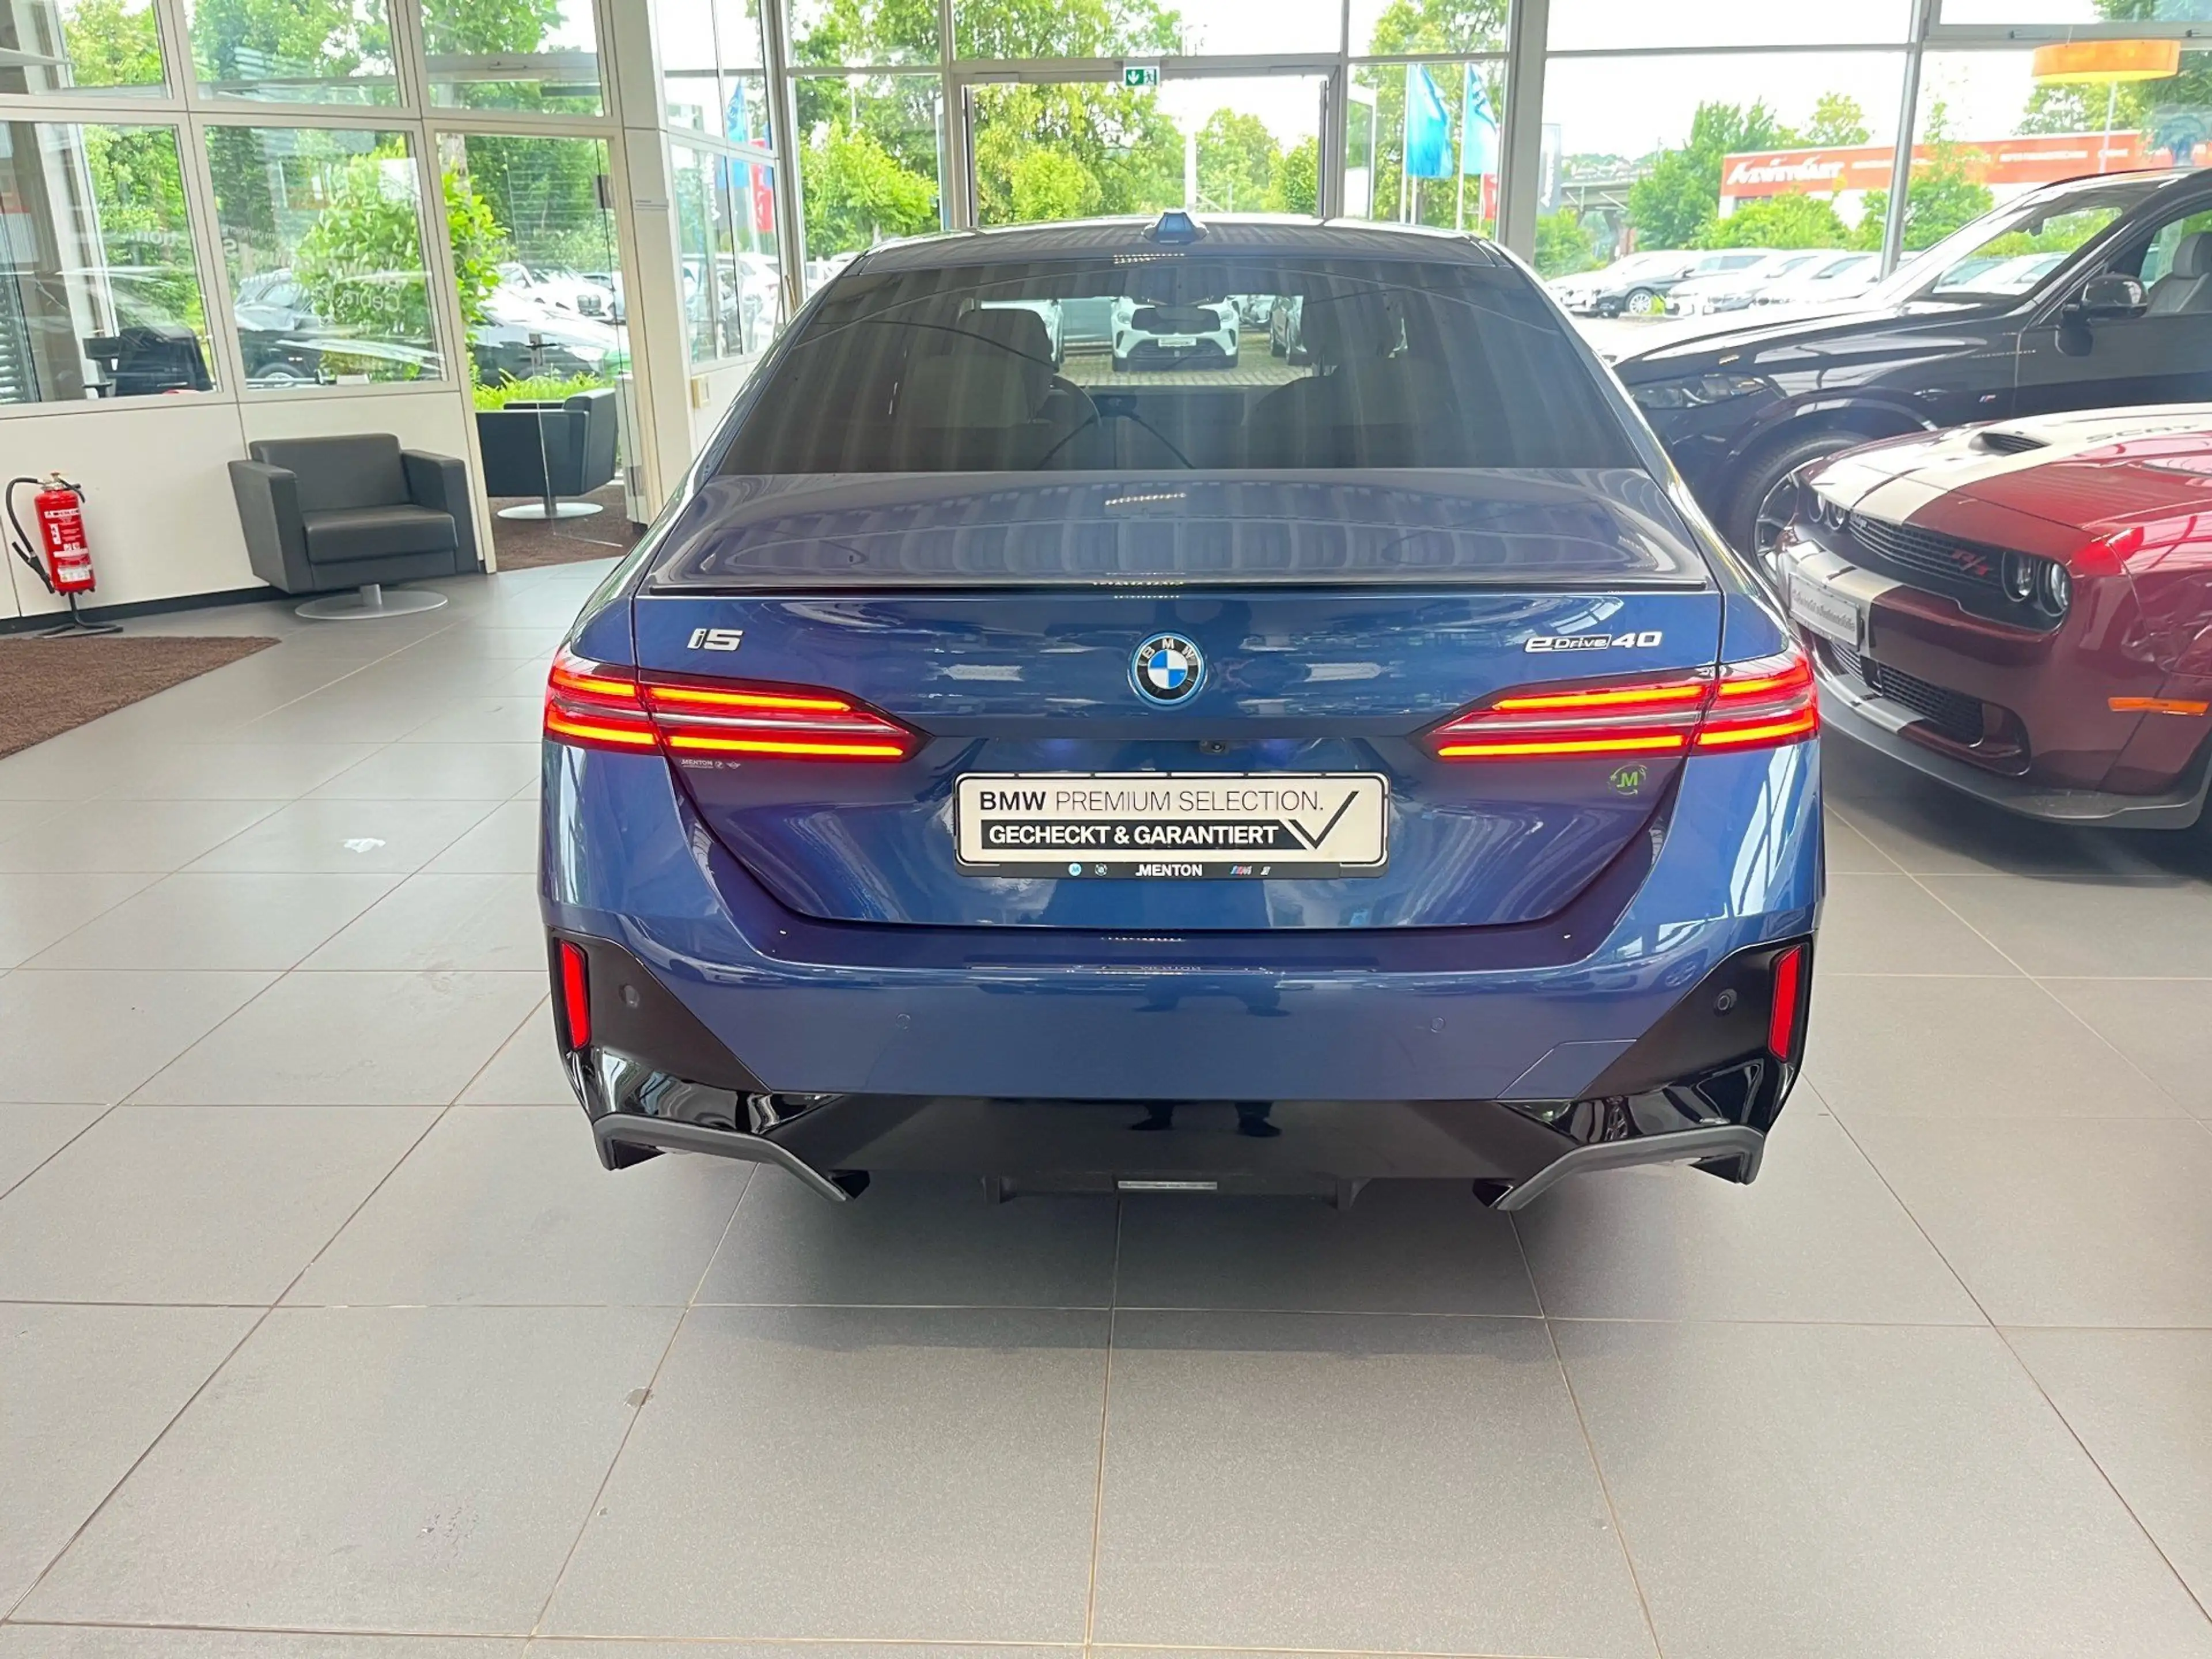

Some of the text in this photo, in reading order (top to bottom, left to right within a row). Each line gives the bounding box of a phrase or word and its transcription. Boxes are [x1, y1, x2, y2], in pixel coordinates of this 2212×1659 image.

[687, 628, 744, 651] i5
[1141, 638, 1195, 658] BMW
[980, 790, 1323, 811] BMW PREMIUM SELECTION.
[989, 825, 1279, 844] GECHECKT & GARANTIERT
[1135, 864, 1203, 877] MENTON
